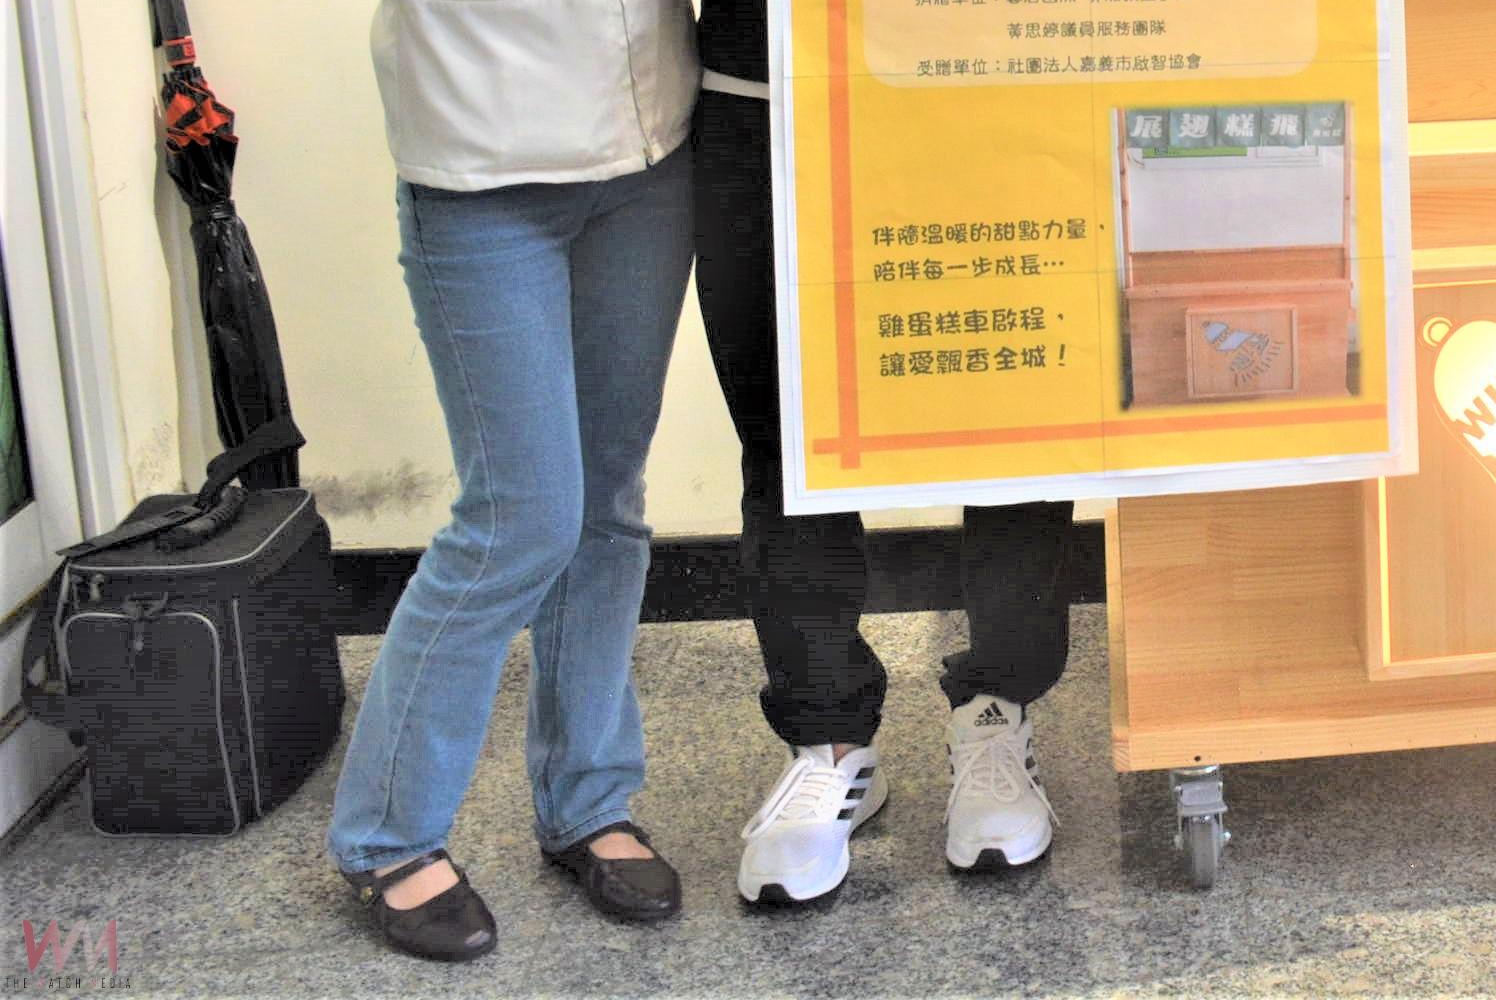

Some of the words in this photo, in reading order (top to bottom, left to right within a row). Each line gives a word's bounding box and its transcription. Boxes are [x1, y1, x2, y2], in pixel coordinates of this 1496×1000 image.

[1007, 20, 1167, 40] 黃思婷議員服務團隊
